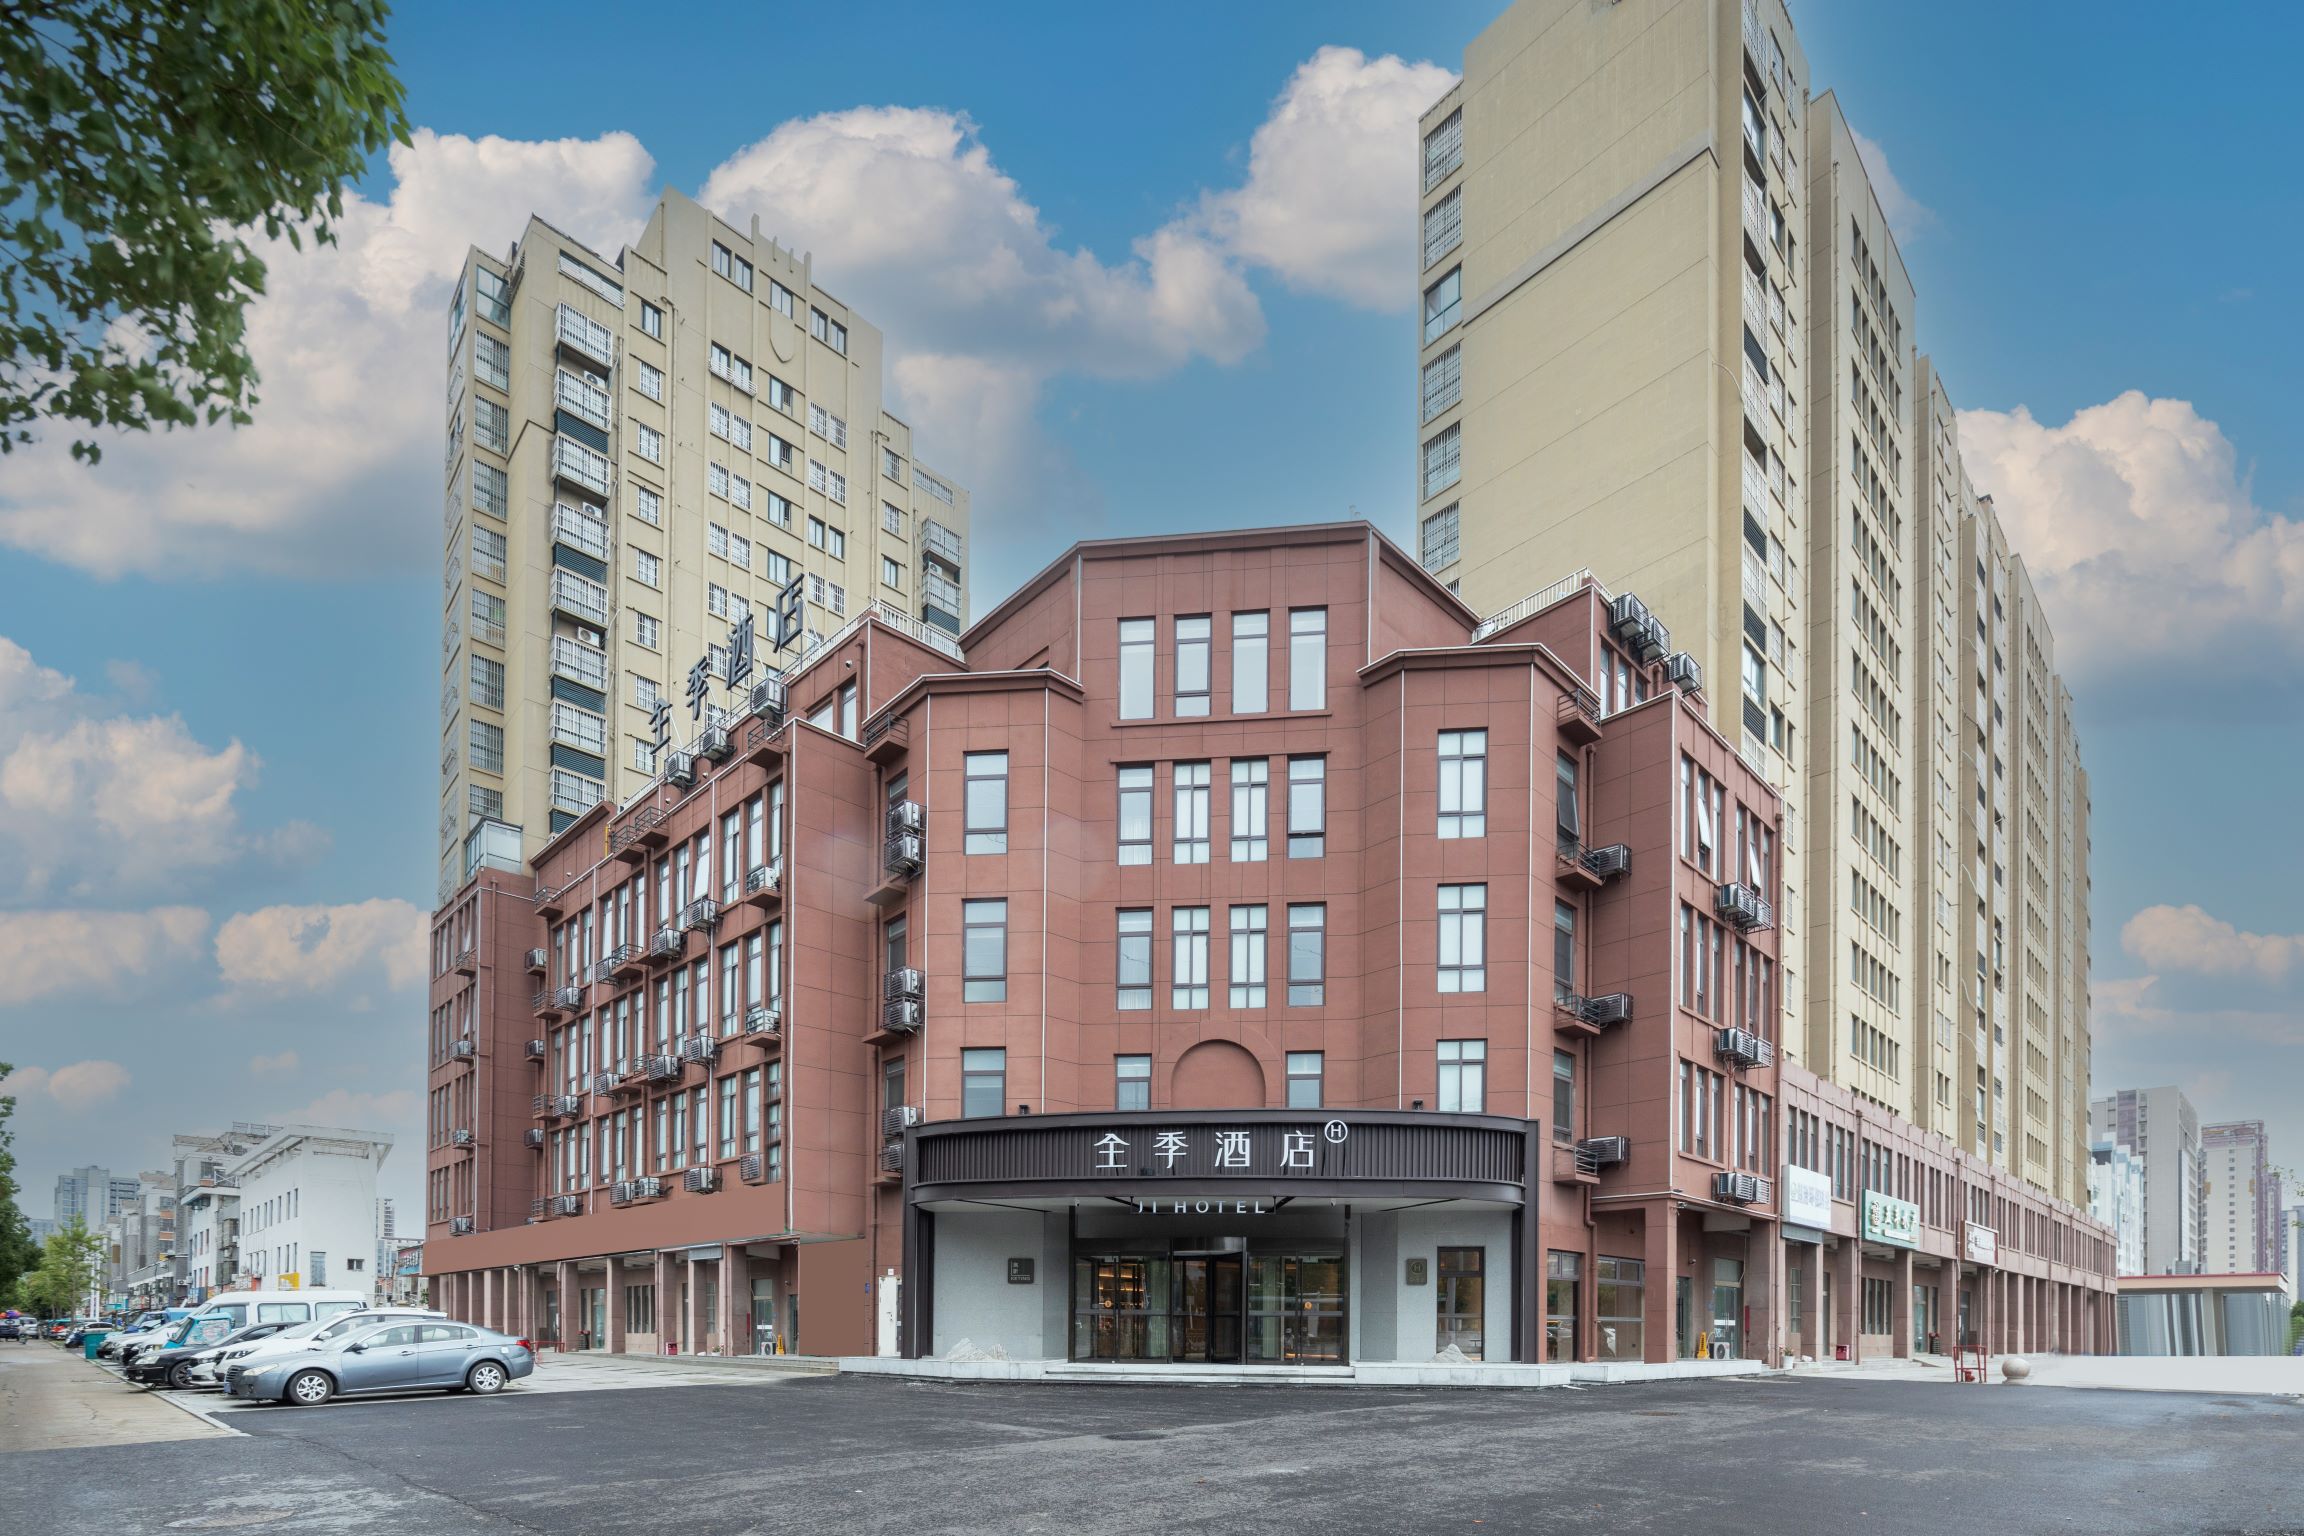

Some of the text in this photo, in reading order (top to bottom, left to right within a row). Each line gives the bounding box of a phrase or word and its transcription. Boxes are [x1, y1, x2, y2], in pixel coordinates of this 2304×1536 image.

[1093, 1129, 1316, 1169] 全季酒店
[1138, 1200, 1266, 1214] JI HOTEL
